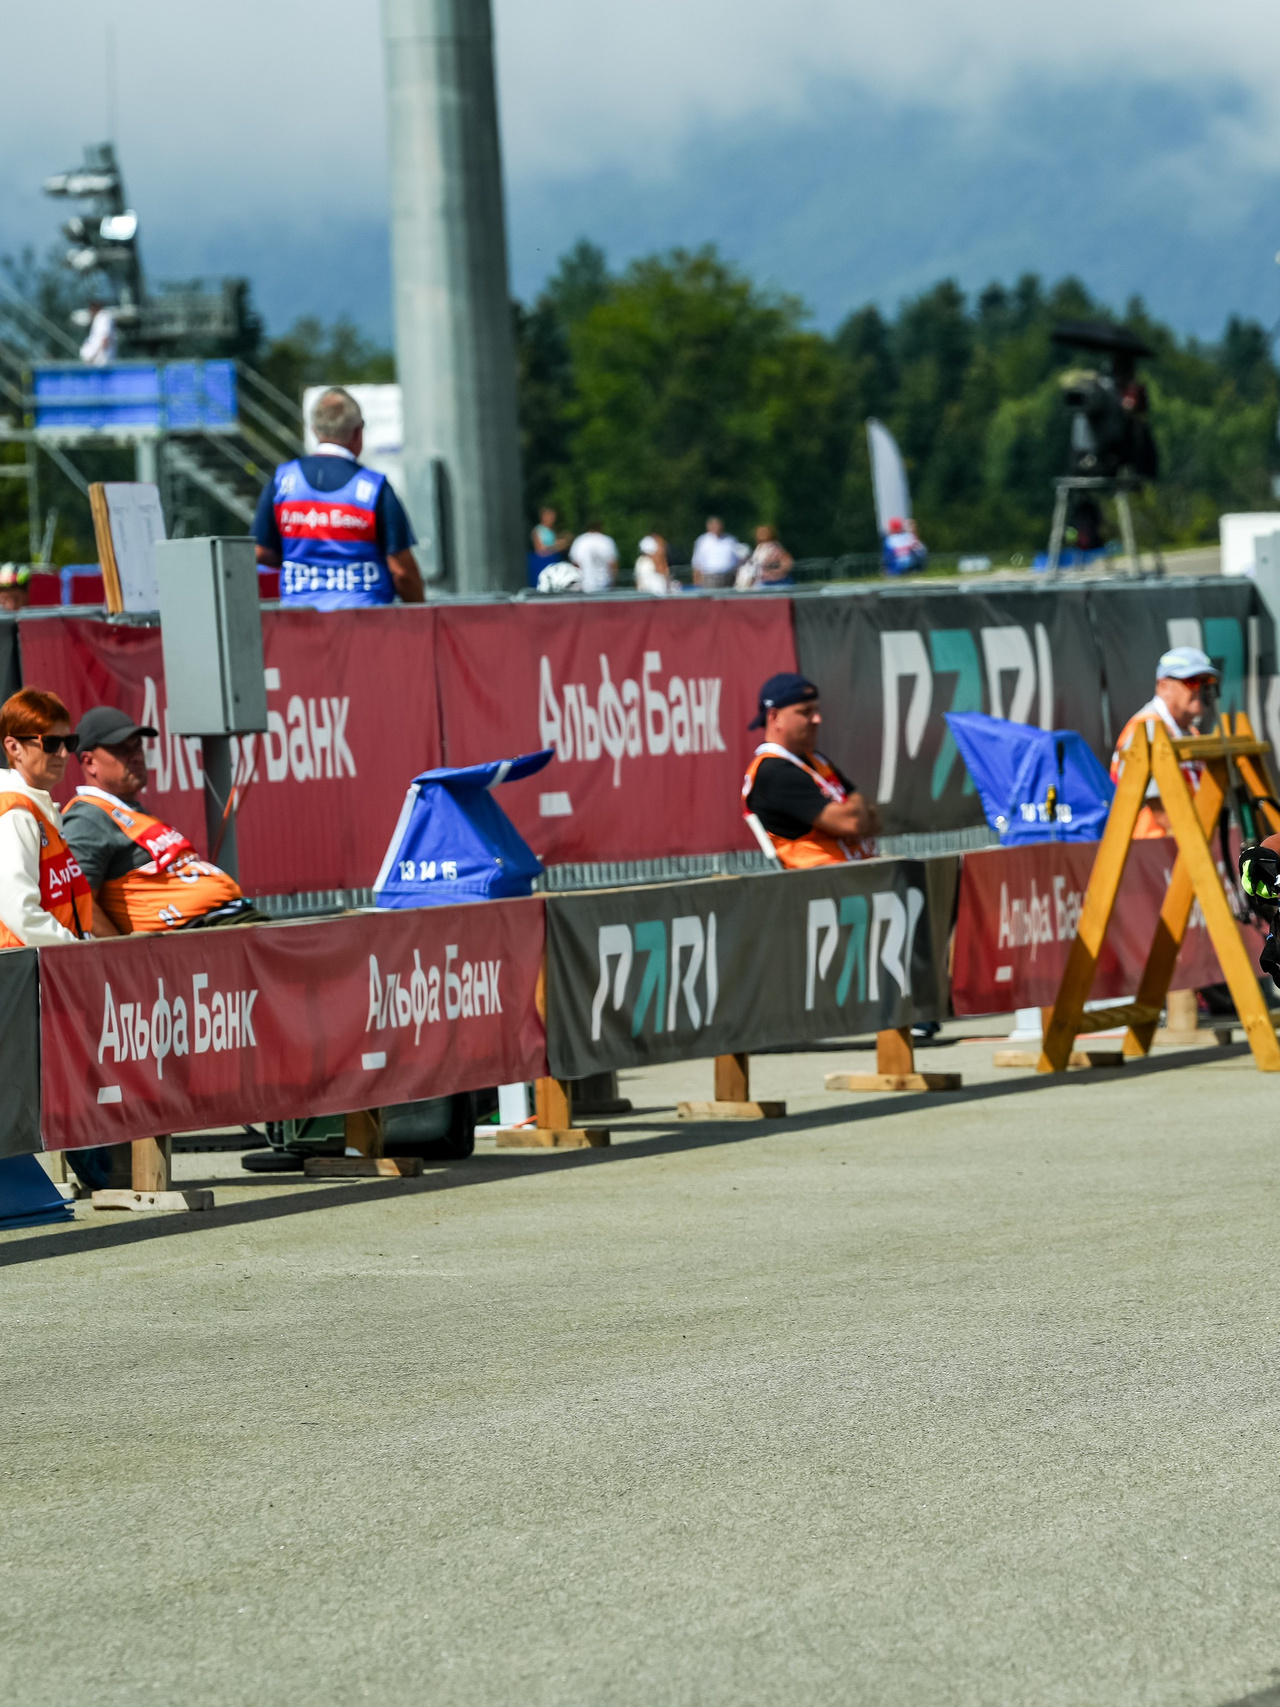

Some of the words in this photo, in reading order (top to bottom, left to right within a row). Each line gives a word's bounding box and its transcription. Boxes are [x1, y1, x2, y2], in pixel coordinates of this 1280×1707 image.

[398, 860, 415, 882] 13
[420, 860, 437, 882] 14
[440, 860, 458, 881] 15
[365, 948, 440, 1046] Альфа
[444, 943, 503, 1021] Банк
[591, 911, 719, 1042] PARI
[805, 887, 925, 1011] PARI
[98, 980, 189, 1080] Альфа
[193, 972, 259, 1054] Банк
